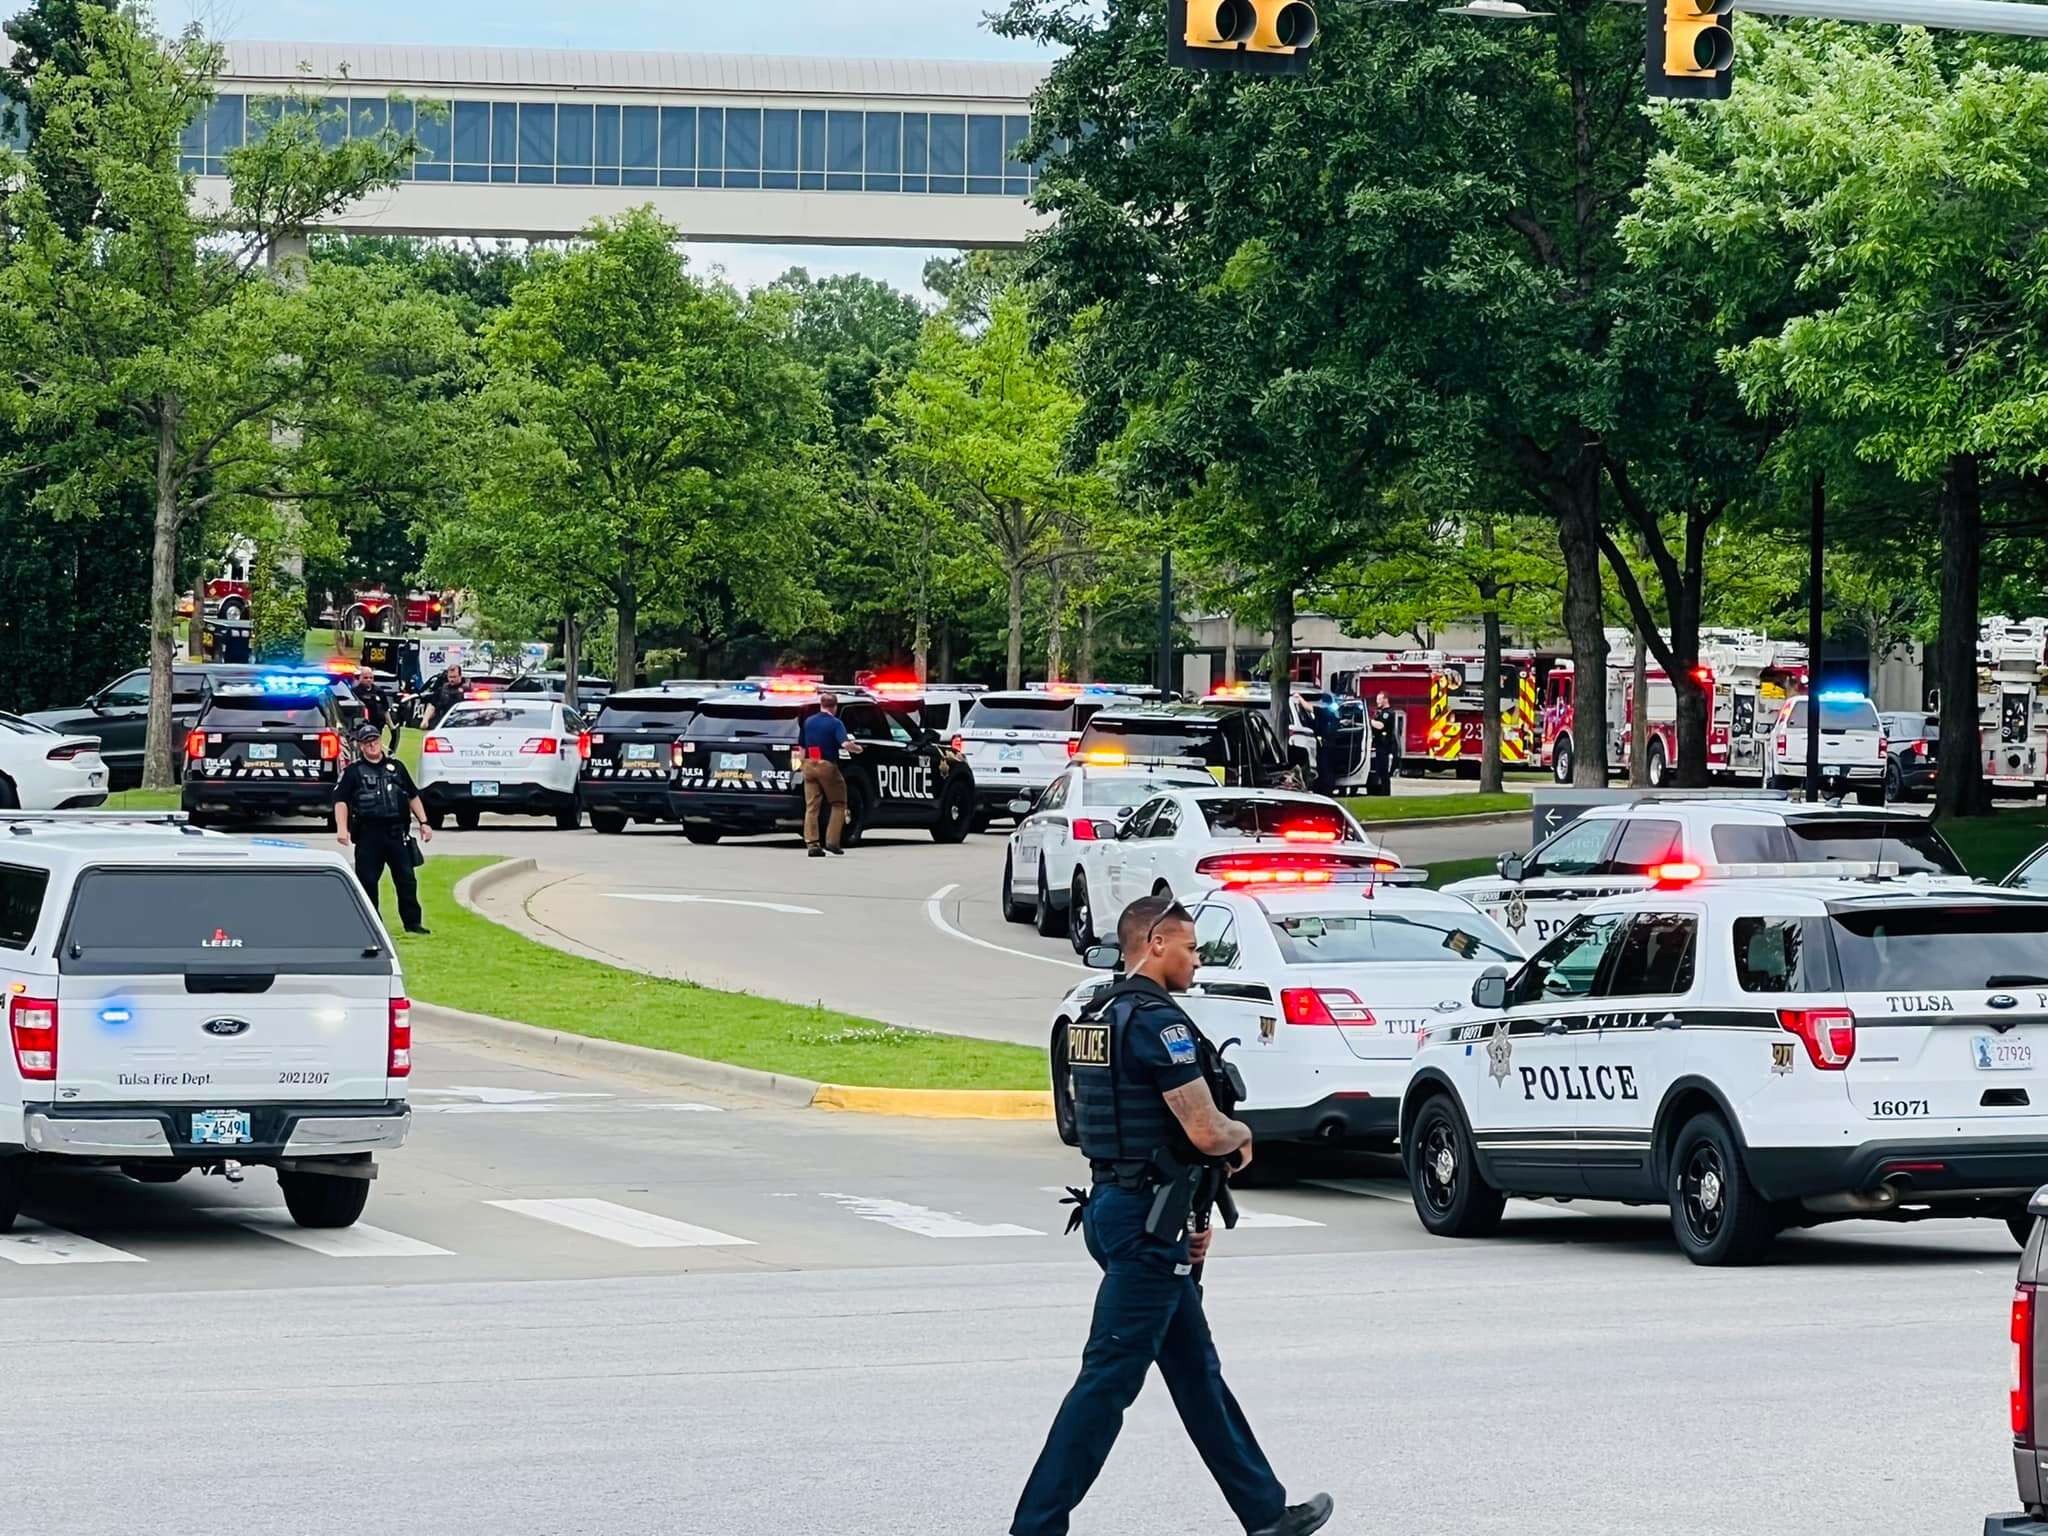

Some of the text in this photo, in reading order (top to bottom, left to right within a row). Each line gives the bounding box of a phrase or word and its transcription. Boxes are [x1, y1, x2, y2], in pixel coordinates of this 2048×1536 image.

[1464, 722, 1484, 740] 23
[204, 758, 321, 767] TULSA POLICE
[591, 758, 613, 767] TULSA
[681, 767, 791, 780] TULSA POLICE
[877, 764, 935, 799] POLICE
[201, 939, 244, 947] LEER
[1887, 996, 1954, 1012] TULSA
[1385, 1019, 1426, 1034] TUL
[1586, 1012, 1648, 1030] TULSA
[1069, 1028, 1106, 1061] POLICE
[1996, 1045, 2031, 1062] 27929
[117, 1072, 330, 1086] Tulsa Fire Dept. 2021207
[1518, 1065, 1639, 1101] POLICE
[1872, 1100, 1930, 1115] 16071
